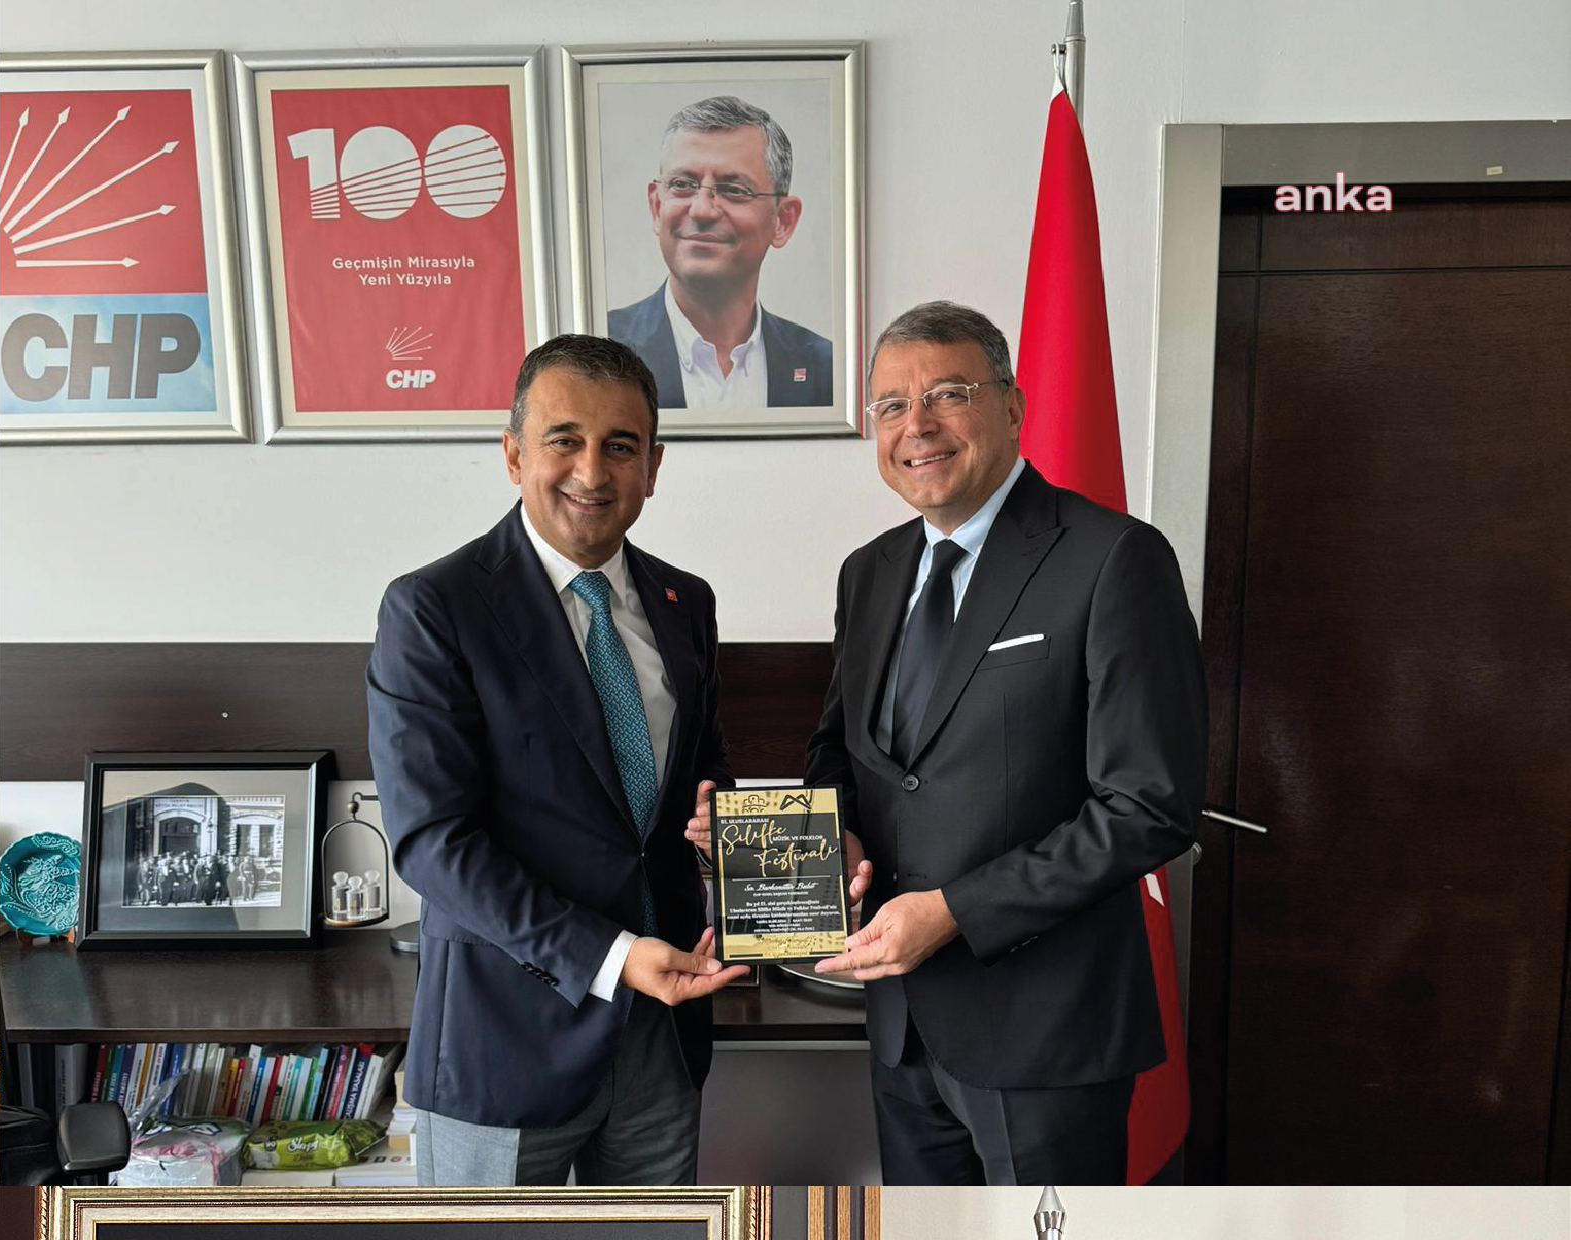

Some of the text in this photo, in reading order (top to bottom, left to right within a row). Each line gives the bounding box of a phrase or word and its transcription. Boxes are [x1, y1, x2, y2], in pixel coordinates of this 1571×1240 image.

[287, 125, 507, 220] 100
[332, 255, 475, 271] Geçmişin Mirasıyla
[359, 273, 452, 288] Yeni Yüzyıla
[1, 312, 201, 402] CHP
[386, 369, 436, 389] CHP
